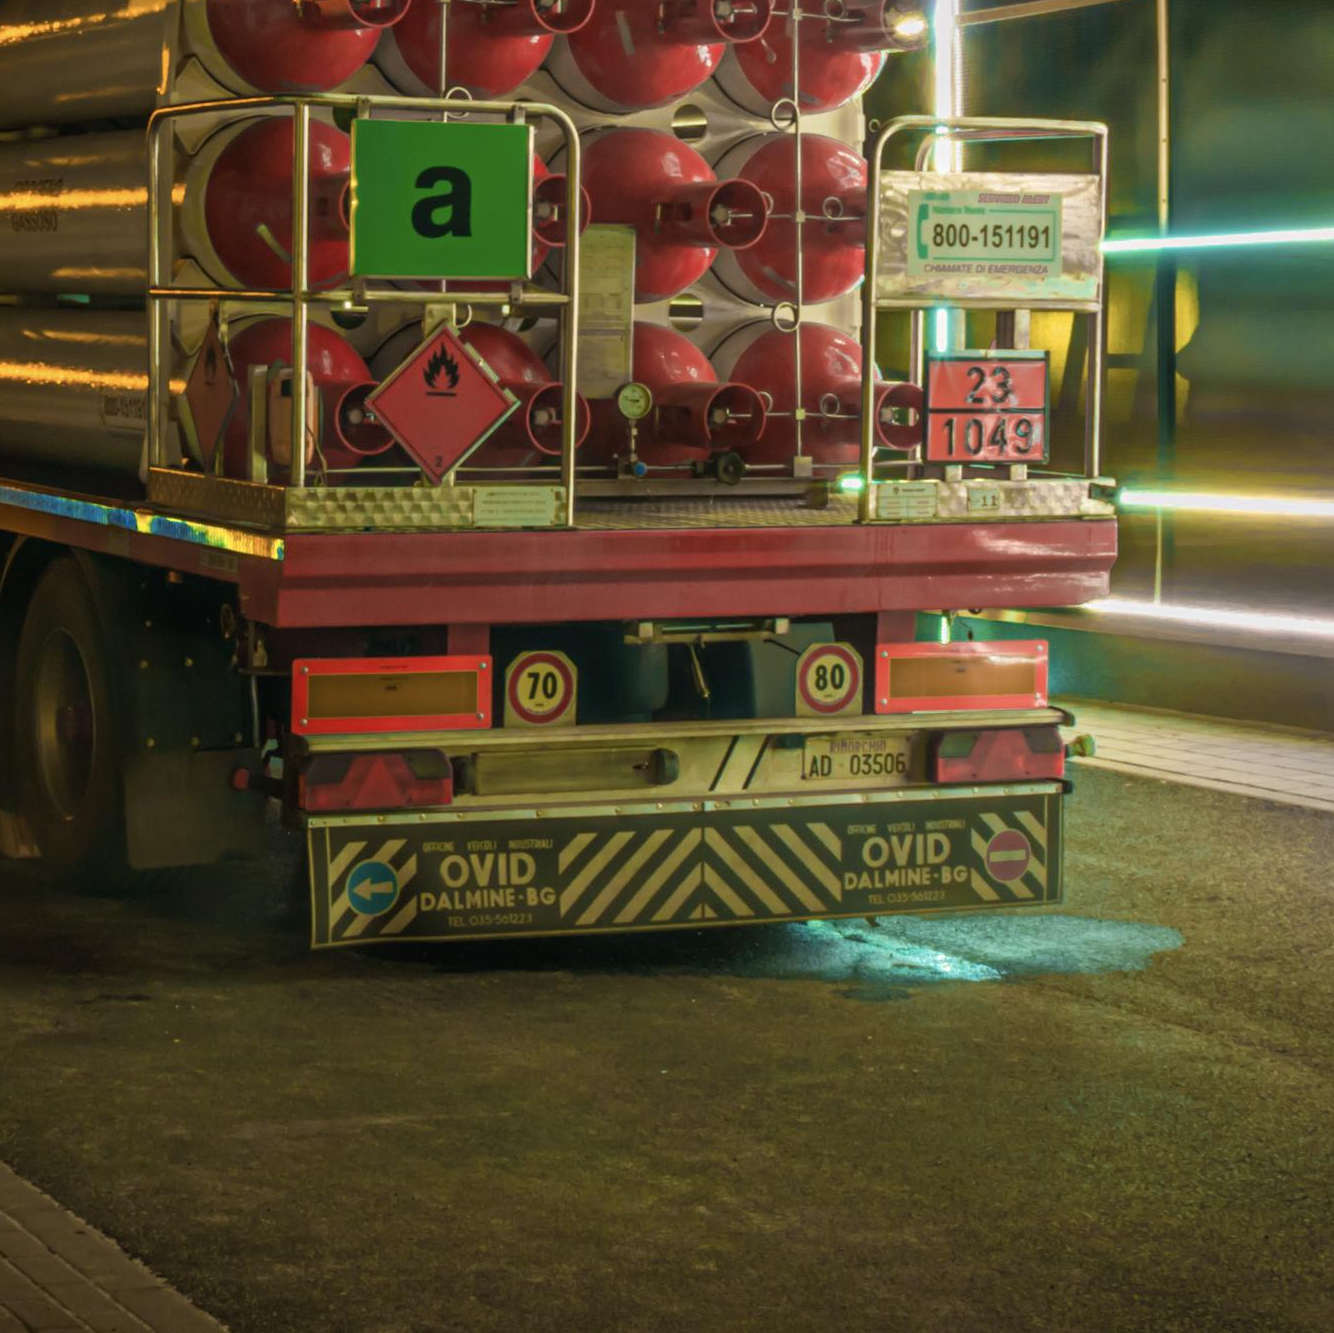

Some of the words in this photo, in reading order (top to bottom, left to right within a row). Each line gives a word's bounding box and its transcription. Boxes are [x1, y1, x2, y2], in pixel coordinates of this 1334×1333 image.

[411, 165, 472, 238] a
[932, 223, 1049, 248] 800-151191
[965, 366, 1011, 404] 23
[942, 418, 1033, 455] 1049
[435, 455, 443, 468] 2
[527, 671, 558, 700] 70
[814, 663, 845, 691] 80
[809, 754, 832, 777] AD
[849, 753, 906, 775] 03506
[862, 832, 952, 868] OVID
[439, 852, 536, 888] OVID
